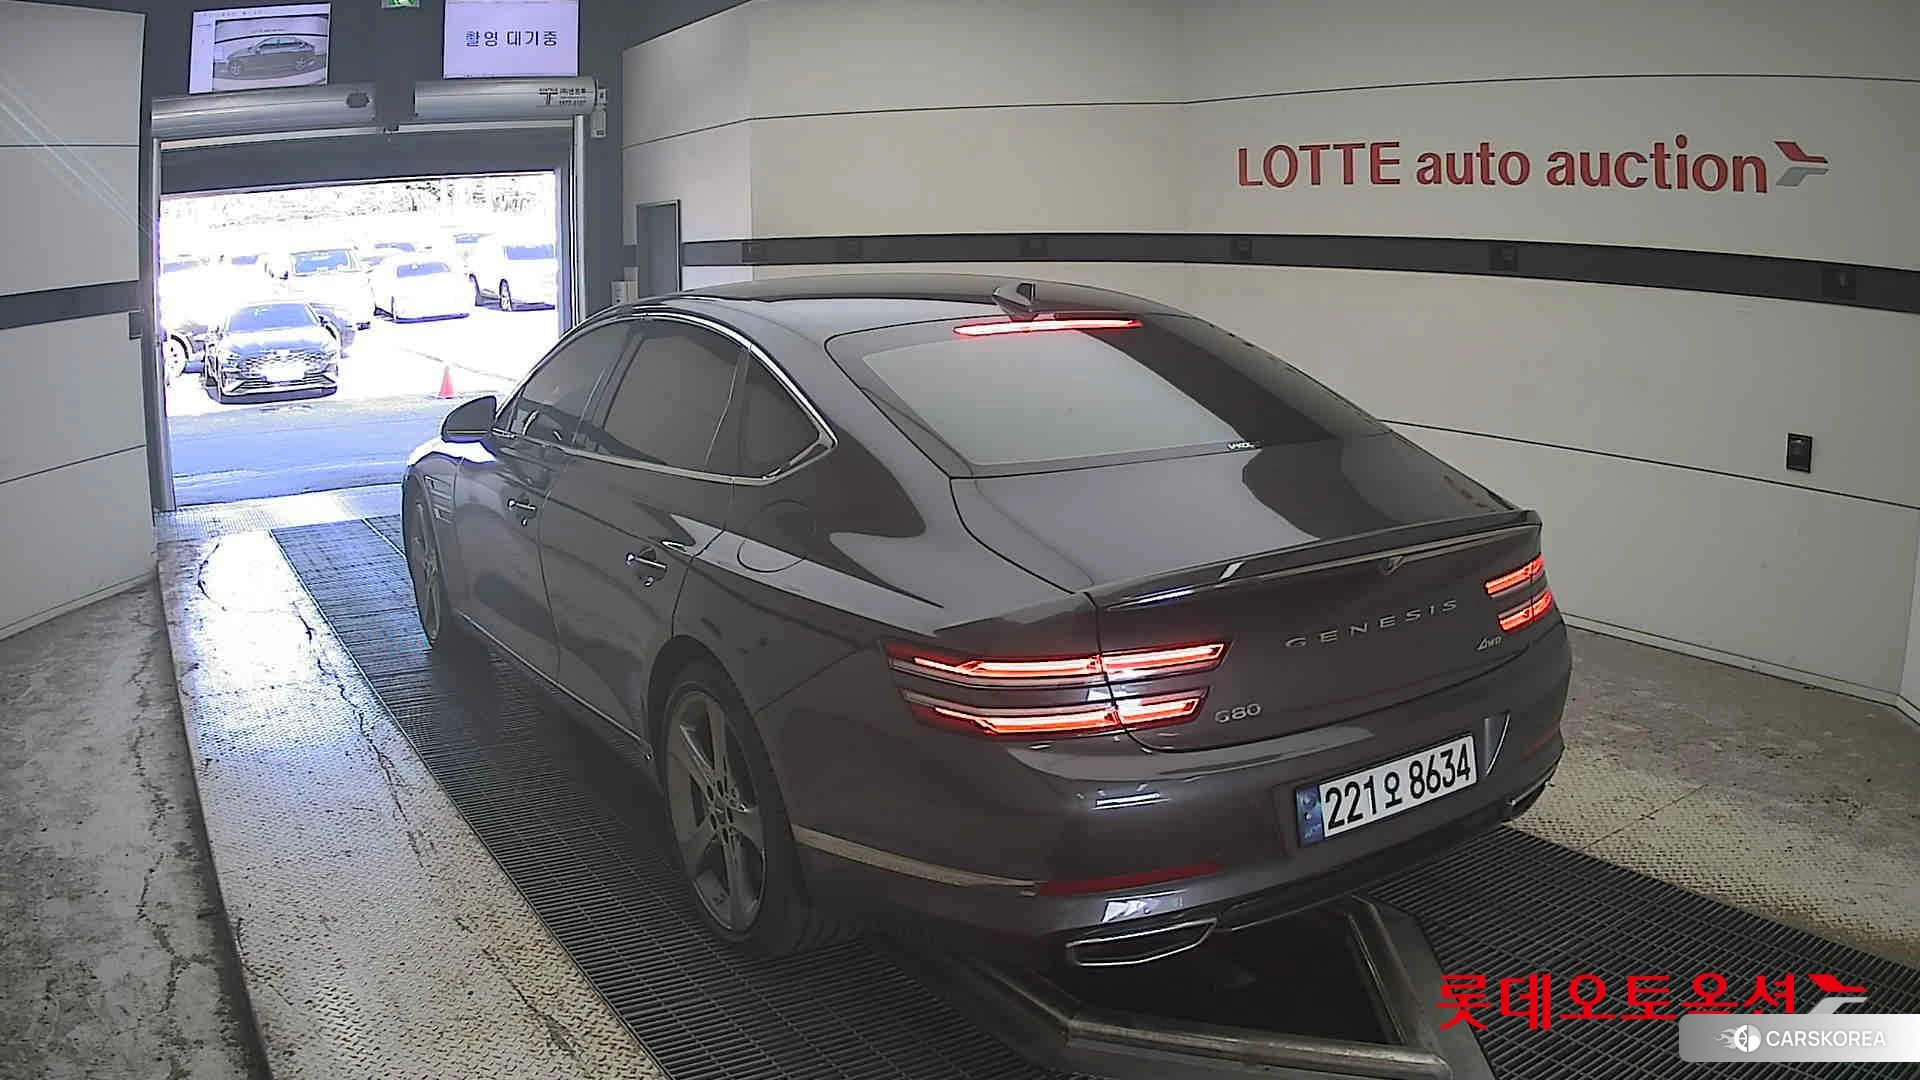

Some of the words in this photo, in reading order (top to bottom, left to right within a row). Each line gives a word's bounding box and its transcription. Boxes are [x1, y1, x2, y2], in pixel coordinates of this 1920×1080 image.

[465, 30, 498, 47] 촬영
[506, 30, 558, 47] 대기중
[1238, 142, 1400, 188] LOTTE
[1415, 142, 1531, 187] auto
[1546, 134, 1769, 194] auction
[1285, 599, 1458, 648] GENESIS
[1214, 703, 1262, 723] G80
[1324, 771, 1402, 830] 221오
[1408, 743, 1471, 800] 8634
